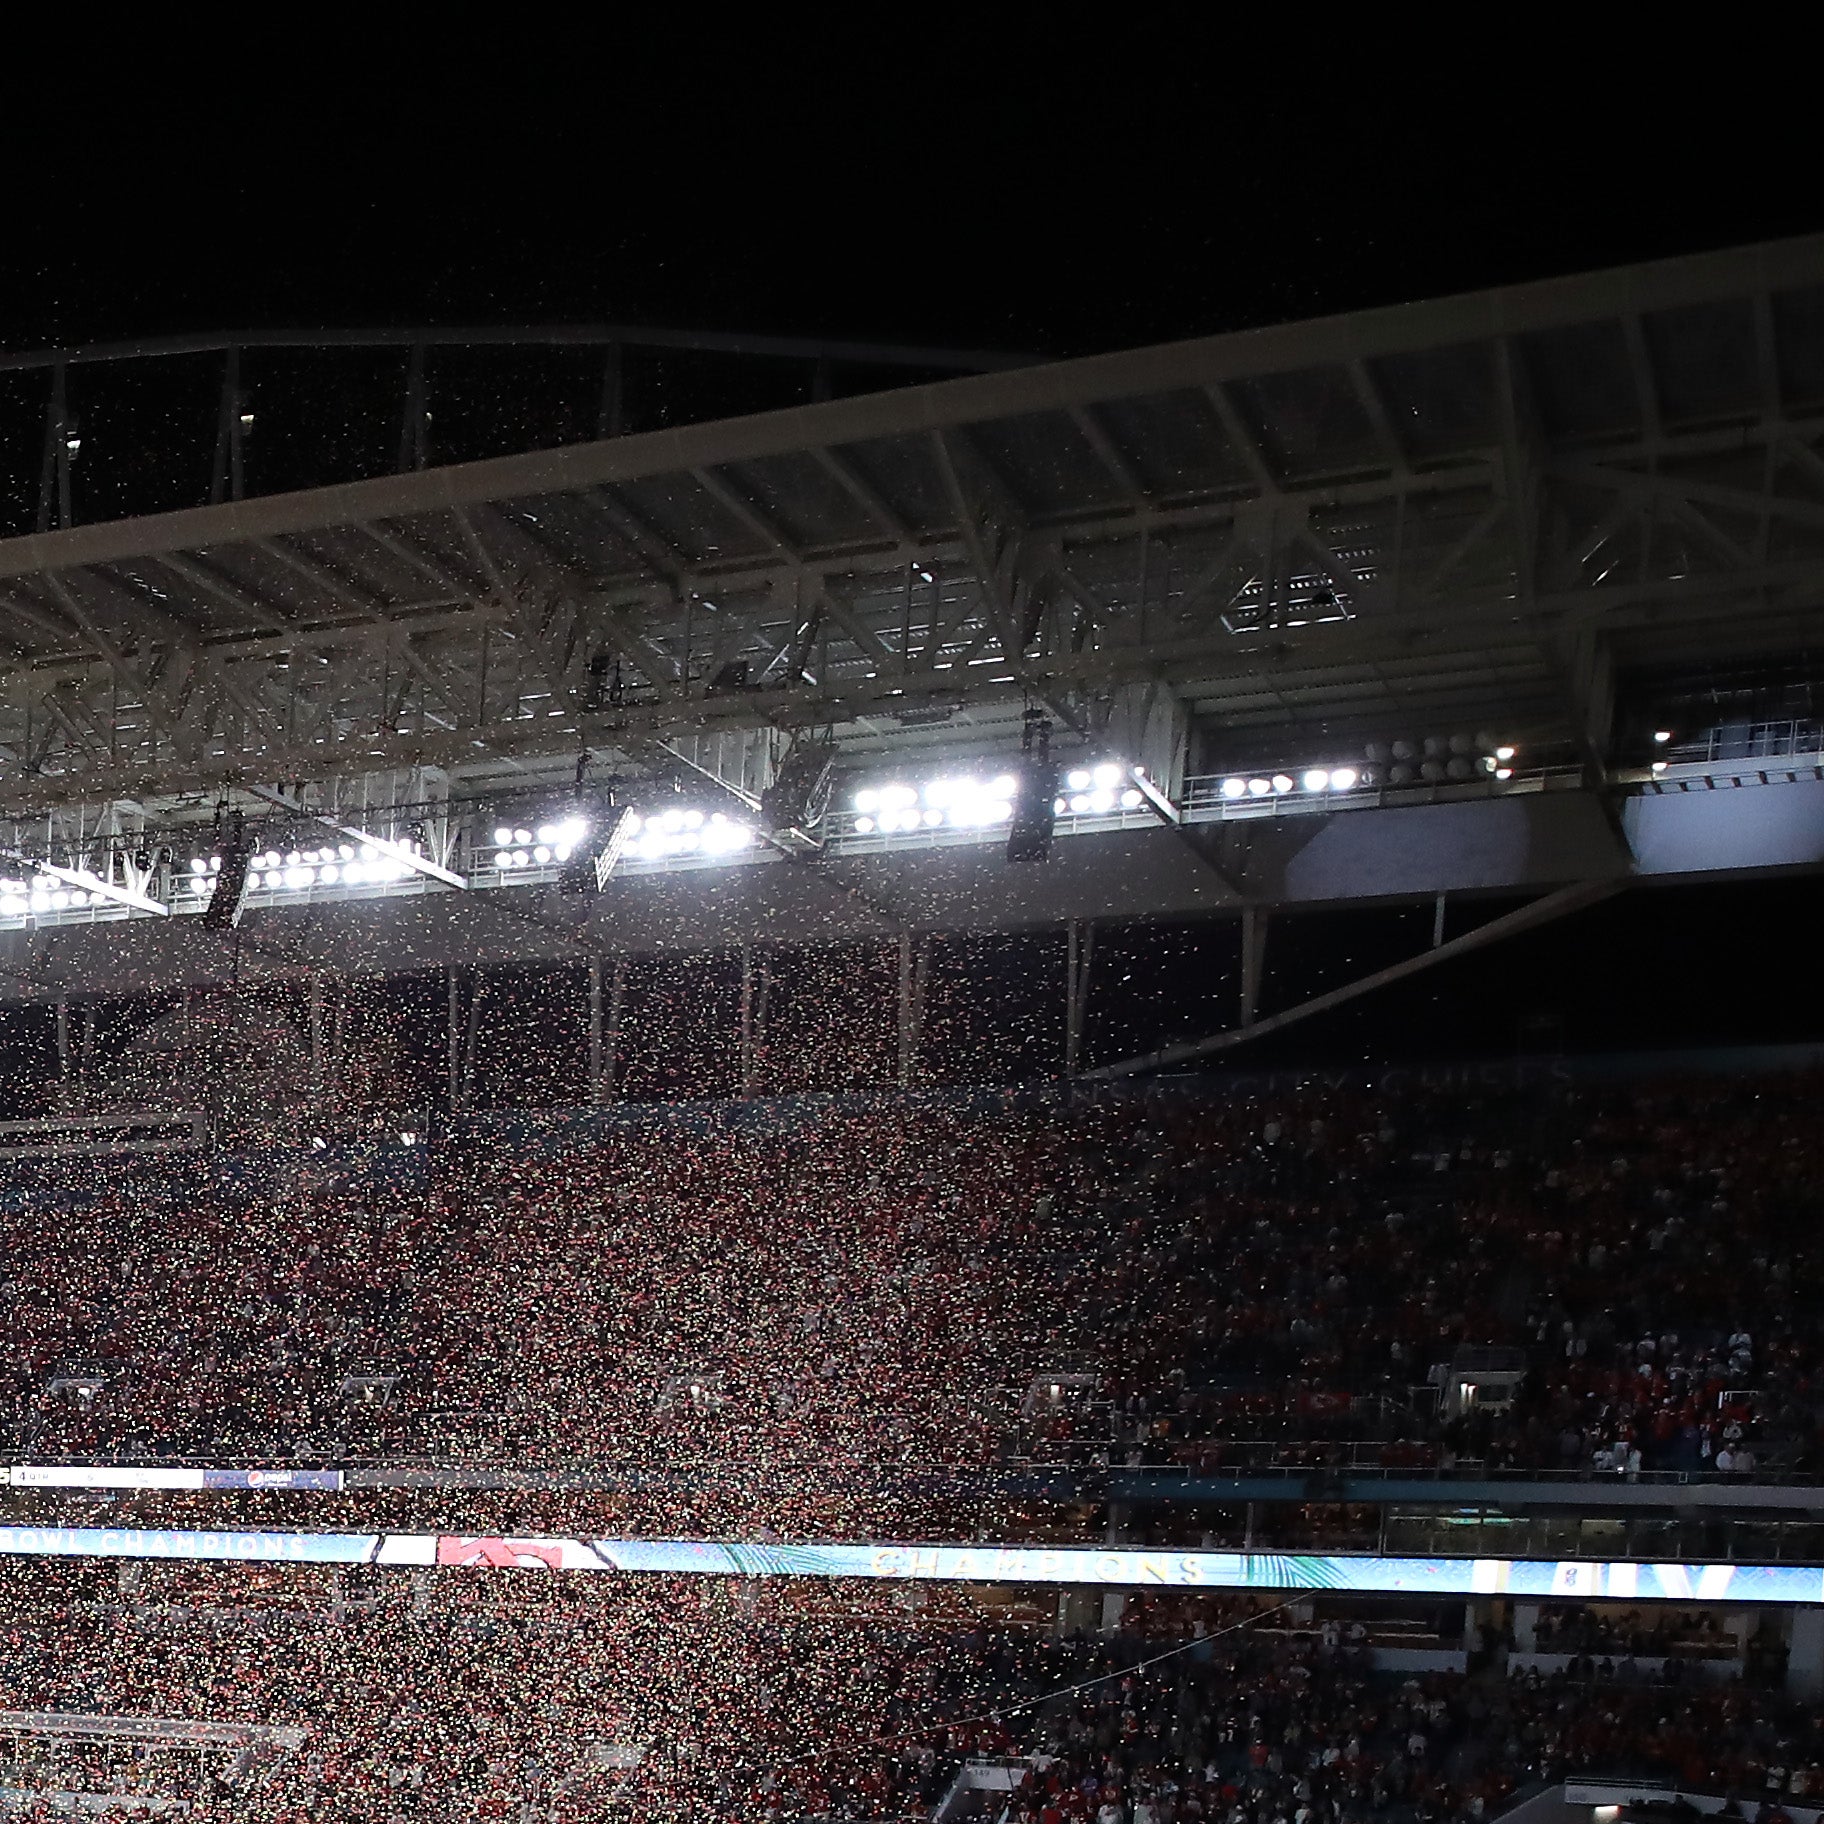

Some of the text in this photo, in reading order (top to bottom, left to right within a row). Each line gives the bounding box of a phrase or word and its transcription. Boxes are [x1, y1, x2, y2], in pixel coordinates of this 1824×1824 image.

[19, 1471, 26, 1482] 4
[102, 1531, 305, 1556] CHAMPIONS
[870, 1549, 1205, 1584] CHAMPIONS
